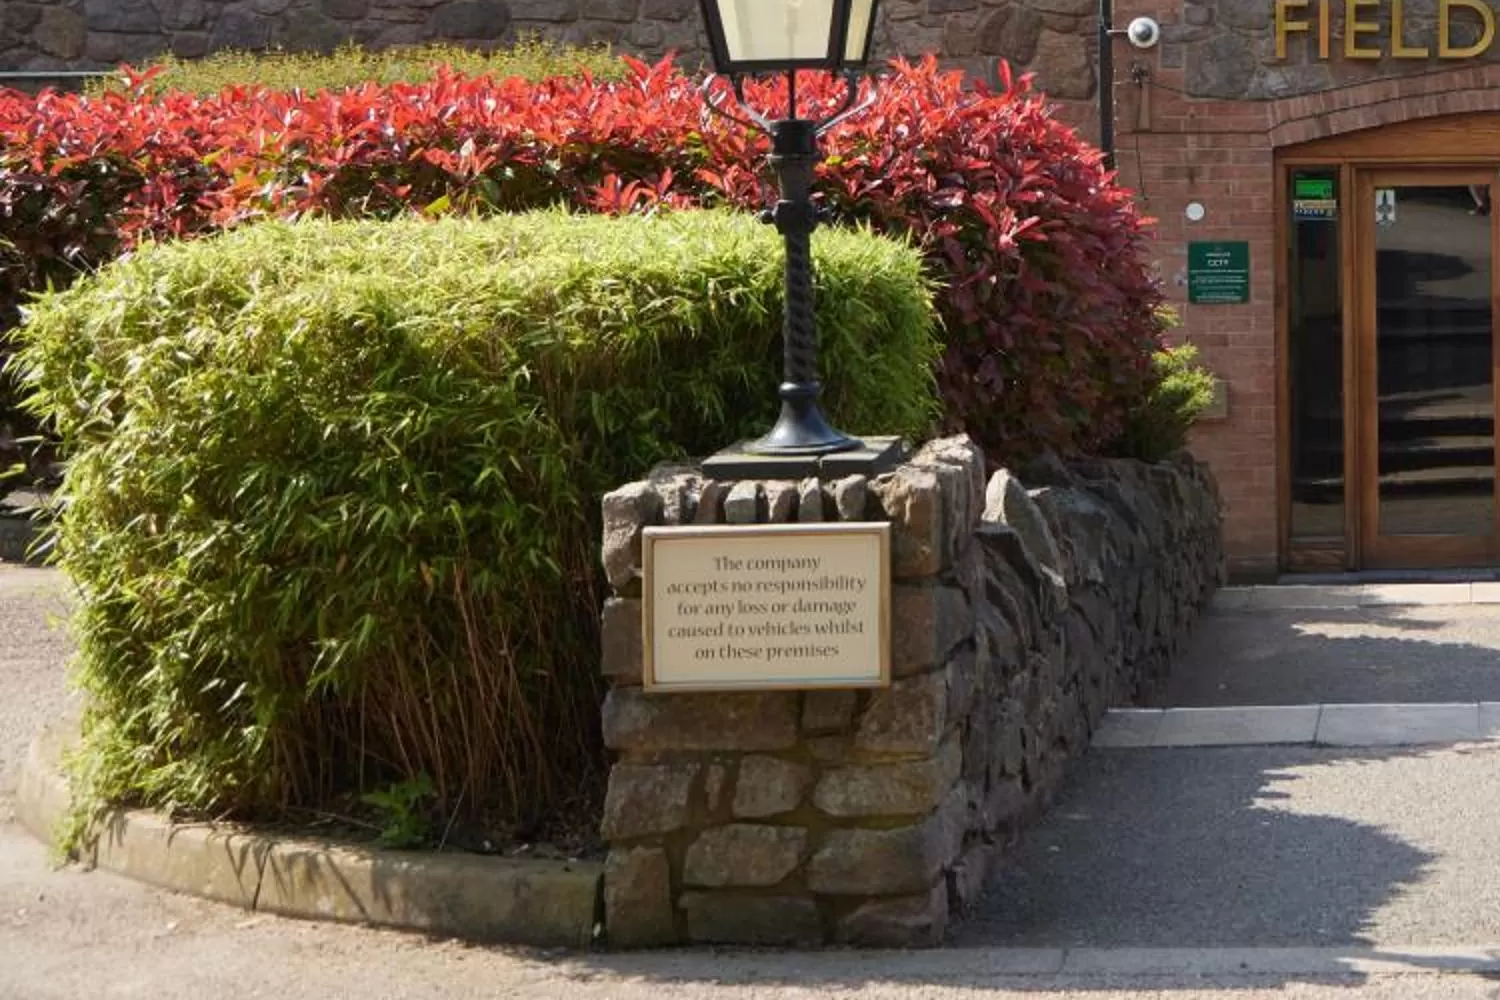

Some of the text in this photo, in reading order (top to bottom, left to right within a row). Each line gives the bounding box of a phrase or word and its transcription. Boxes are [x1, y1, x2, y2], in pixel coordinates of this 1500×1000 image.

[714, 556, 822, 572] The company
[666, 575, 867, 596] accepts no responsibility
[677, 597, 857, 617] for any loss or damage
[668, 619, 864, 639] caused to vehicles whilst
[694, 644, 840, 661] on these premises
